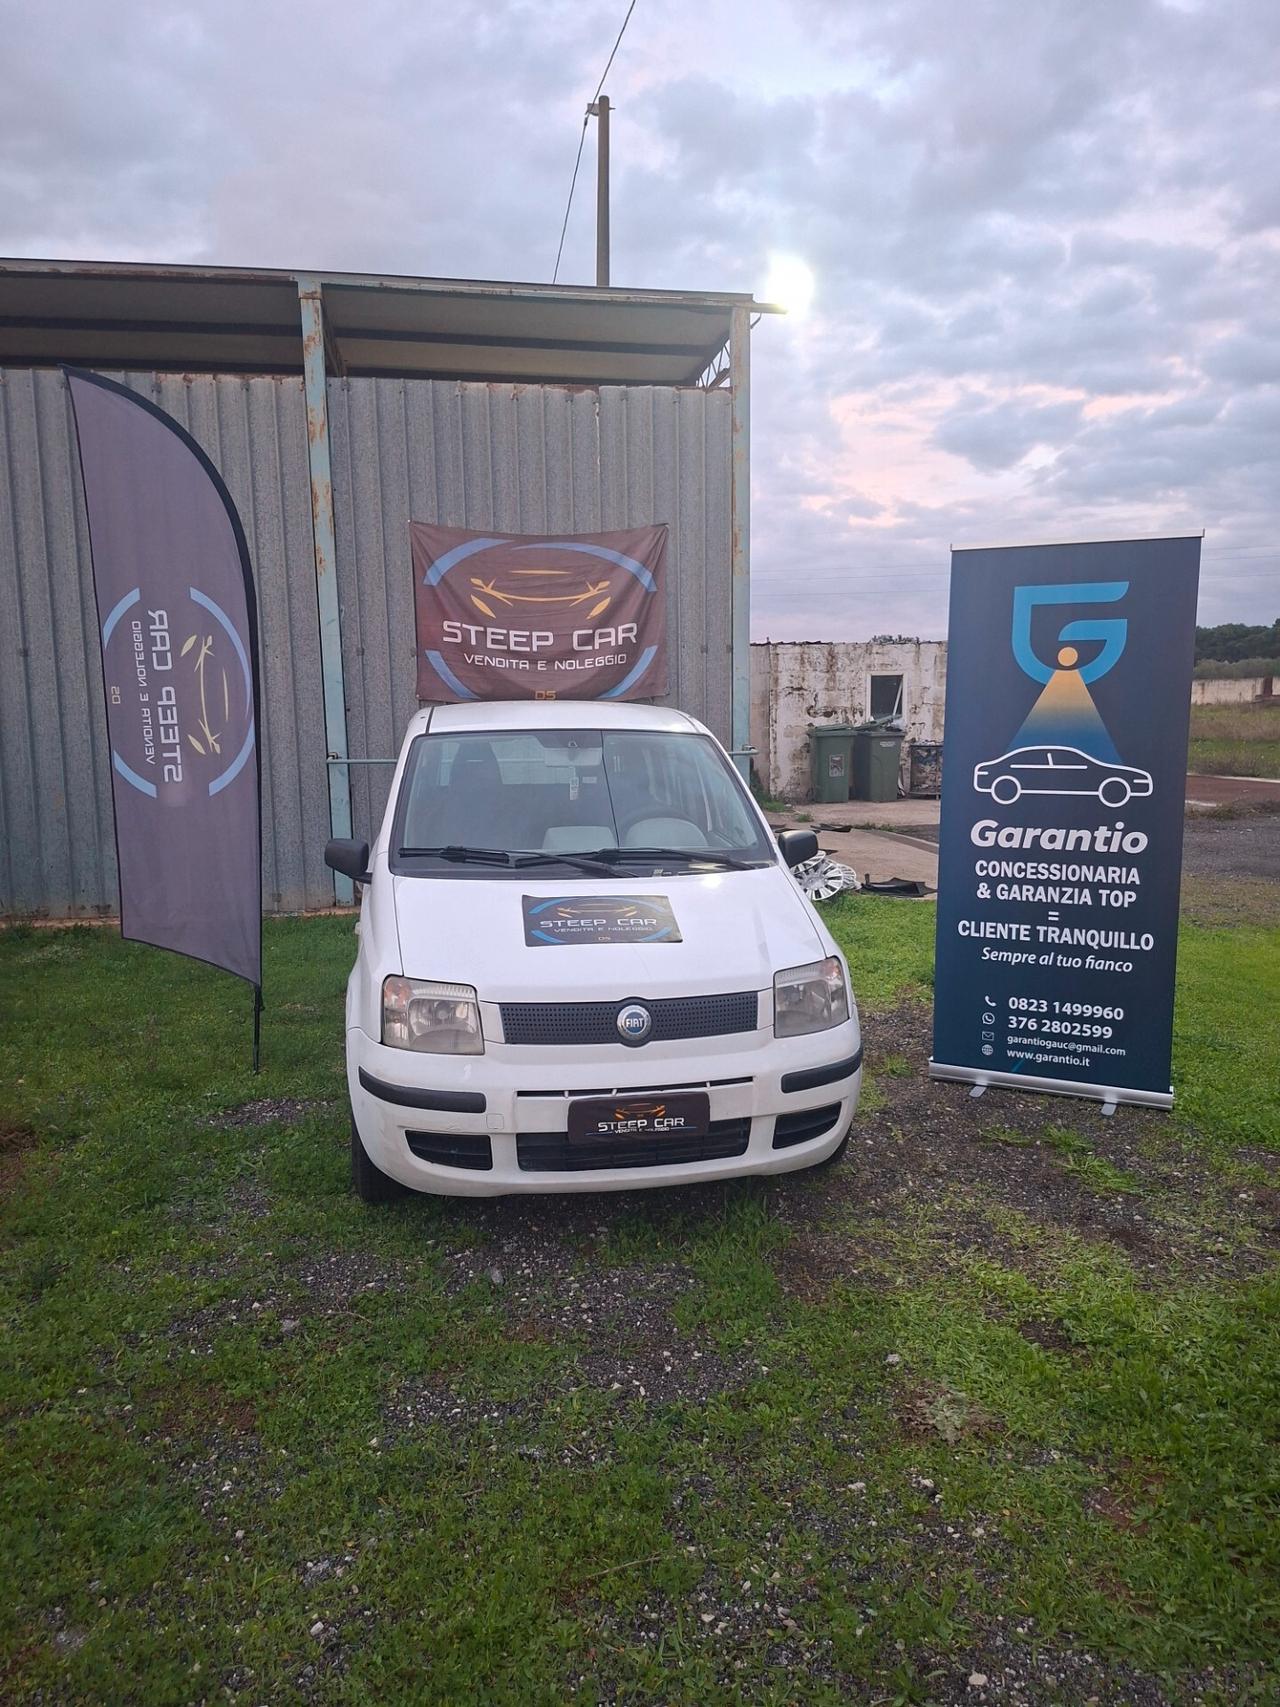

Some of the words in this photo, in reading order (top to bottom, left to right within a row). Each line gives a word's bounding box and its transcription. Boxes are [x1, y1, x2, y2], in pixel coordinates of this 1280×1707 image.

[442, 620, 554, 651] STEEP
[572, 622, 638, 651] CAR
[464, 653, 529, 670] VENDITA
[537, 660, 547, 670] E
[554, 653, 627, 670] NOLEGGIO
[970, 819, 1148, 854] Garantio
[975, 860, 1141, 885] CONCESSIONARIA
[976, 882, 991, 899] &
[996, 883, 1092, 905] GARANZIA
[1099, 889, 1137, 908] TOP
[540, 918, 606, 928] STEEP
[617, 918, 657, 926] CAR
[958, 920, 1032, 942] CLIENTE
[1036, 925, 1154, 950] TRANQUILLO
[981, 946, 1036, 966] Sempre
[1039, 952, 1054, 966] al
[1056, 954, 1082, 968] tuo
[1085, 955, 1133, 972] fianco
[1008, 996, 1048, 1012] 0823
[1053, 1001, 1124, 1020] 1499960
[626, 1018, 644, 1028] FIAT
[1008, 1016, 1038, 1030] 376
[1041, 1020, 1112, 1038] 2802599
[1007, 1035, 1126, 1056] garantiogauc@gmail.com
[1006, 1049, 1090, 1067] www.garantio.it
[598, 1119, 648, 1132] STEEP
[654, 1117, 684, 1128] CAR
